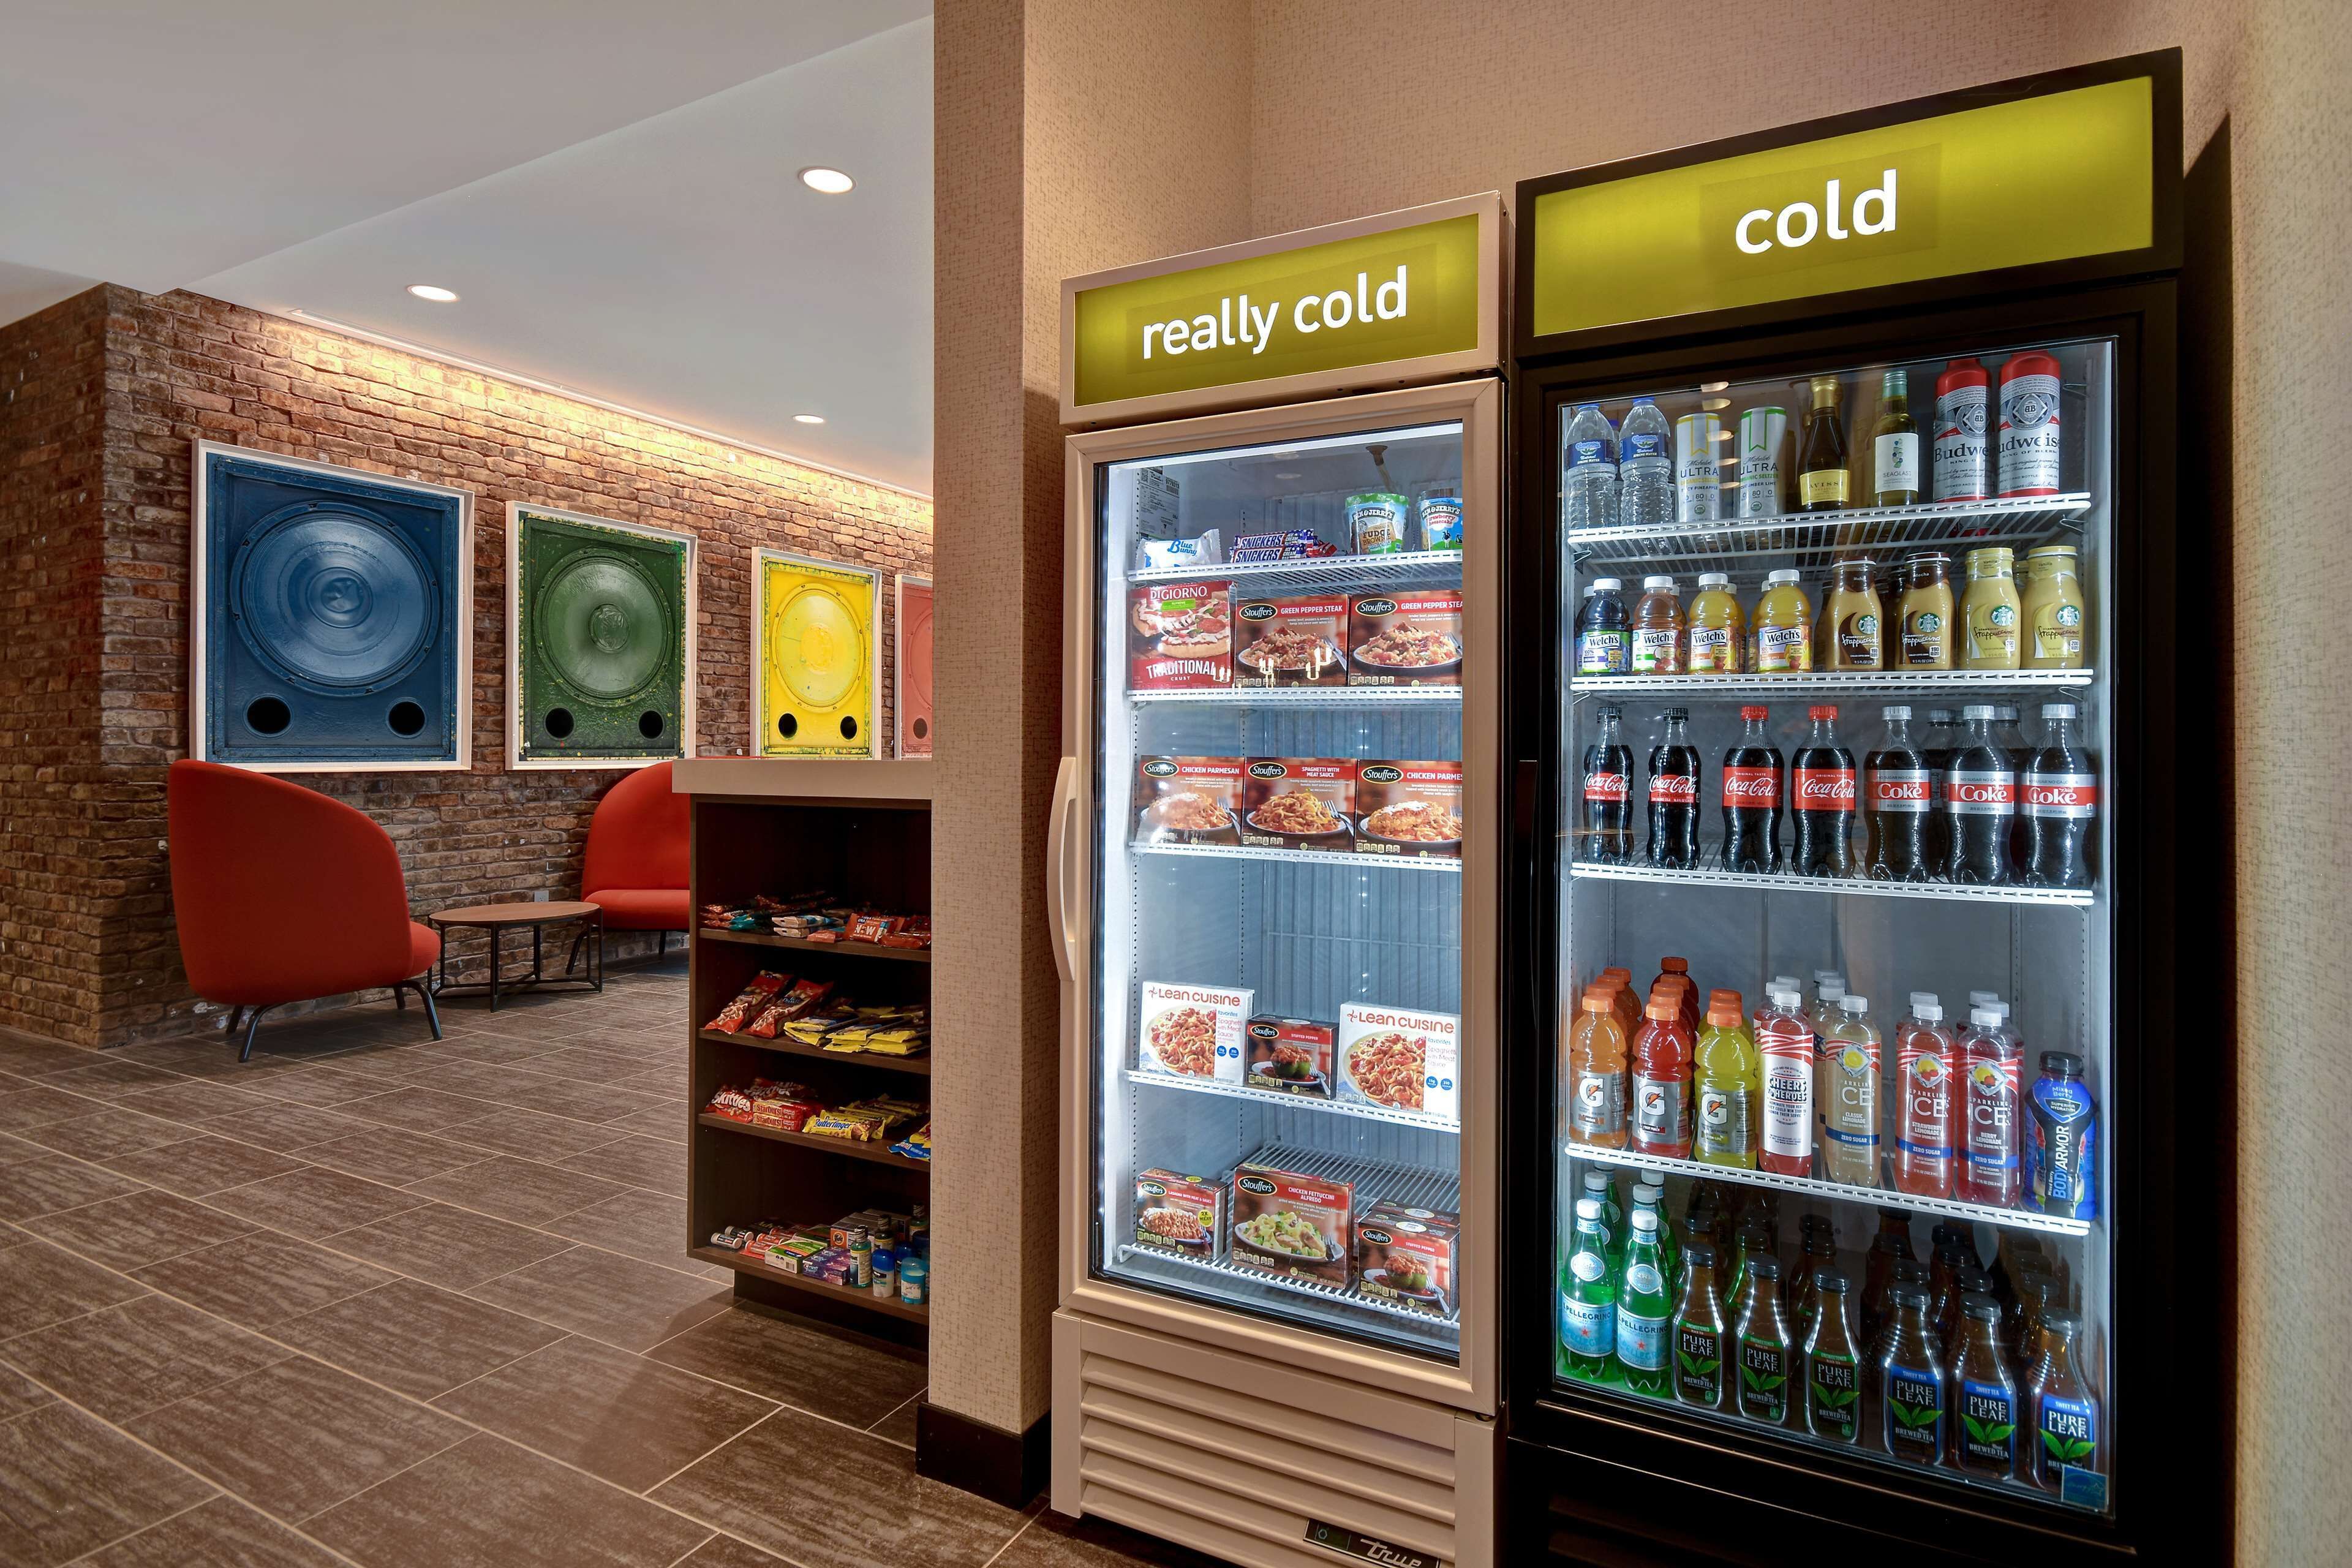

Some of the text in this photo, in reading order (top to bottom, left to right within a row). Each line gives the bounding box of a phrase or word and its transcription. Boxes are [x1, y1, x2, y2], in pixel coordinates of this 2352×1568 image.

[1735, 169, 1897, 254] cold
[1143, 265, 1407, 359] really cold
[1681, 467, 1719, 478] ULTRA
[1242, 534, 1283, 548] SNICKERS
[1236, 549, 1280, 563] SNICKERS
[1244, 608, 1273, 618] Stouffer's
[1360, 601, 1392, 612] Stouffer's
[1589, 636, 1618, 646] Welch's
[1644, 633, 1674, 644] Welch's
[1694, 631, 1725, 644] Welch's
[1767, 630, 1800, 643] Welch's
[1147, 764, 1174, 774] Stouffer's
[1252, 766, 1282, 776] Stouffer's
[1366, 769, 1398, 780] Stouffer's
[1585, 773, 1630, 791] Coca-Cola
[1649, 774, 1698, 794] Coca-Cola
[1725, 777, 1779, 796] Coca-Cola
[1802, 778, 1855, 798] Coca-Cola
[1877, 783, 1922, 799] Coke
[1960, 785, 2007, 802] Coke
[2028, 787, 2078, 804] Coke
[1159, 989, 1189, 1001] Lean
[1359, 1012, 1395, 1026] Lean
[1254, 1027, 1275, 1036] Stouffer's
[1428, 1036, 1451, 1045] favorites
[1579, 1077, 1604, 1107] G
[1770, 1078, 1806, 1092] CHEERS
[711, 1090, 751, 1112] Skittles
[1639, 1085, 1665, 1115] G
[1775, 1090, 1807, 1101] HEROES
[1842, 1087, 1874, 1106] CE
[756, 1103, 782, 1116] Starburst
[1702, 1093, 1727, 1125] G
[1910, 1095, 1949, 1117] ICE
[756, 1114, 782, 1127] Starburst
[1969, 1103, 2010, 1126] ICE
[814, 1115, 852, 1130] Butterfinger
[1912, 1121, 1942, 1130] STRAWBERRY
[1977, 1136, 2002, 1145] LEMONADE
[2052, 1126, 2069, 1199] BODYARMOR
[1144, 1184, 1163, 1194] Stouffer's
[1242, 1179, 1272, 1192] Stouffer's
[1300, 1194, 1321, 1203] ALFREDO
[1309, 1190, 1335, 1200] FETTUCCINI
[1365, 1231, 1389, 1242] Stouffer's
[1686, 1322, 1709, 1332] UNSWEETENED
[1683, 1333, 1713, 1348] PURE
[1747, 1348, 1778, 1363] PURE
[1818, 1363, 1851, 1378] PURE
[1896, 1380, 1934, 1397] PURE
[1747, 1392, 1768, 1401] BREWED
[1970, 1396, 2006, 1412] PURE
[1819, 1409, 1840, 1419] BREWED
[2048, 1411, 2086, 1428] PURE
[1896, 1427, 1934, 1442] BREWED TEA
[1969, 1443, 2009, 1458] BREWED TEA
